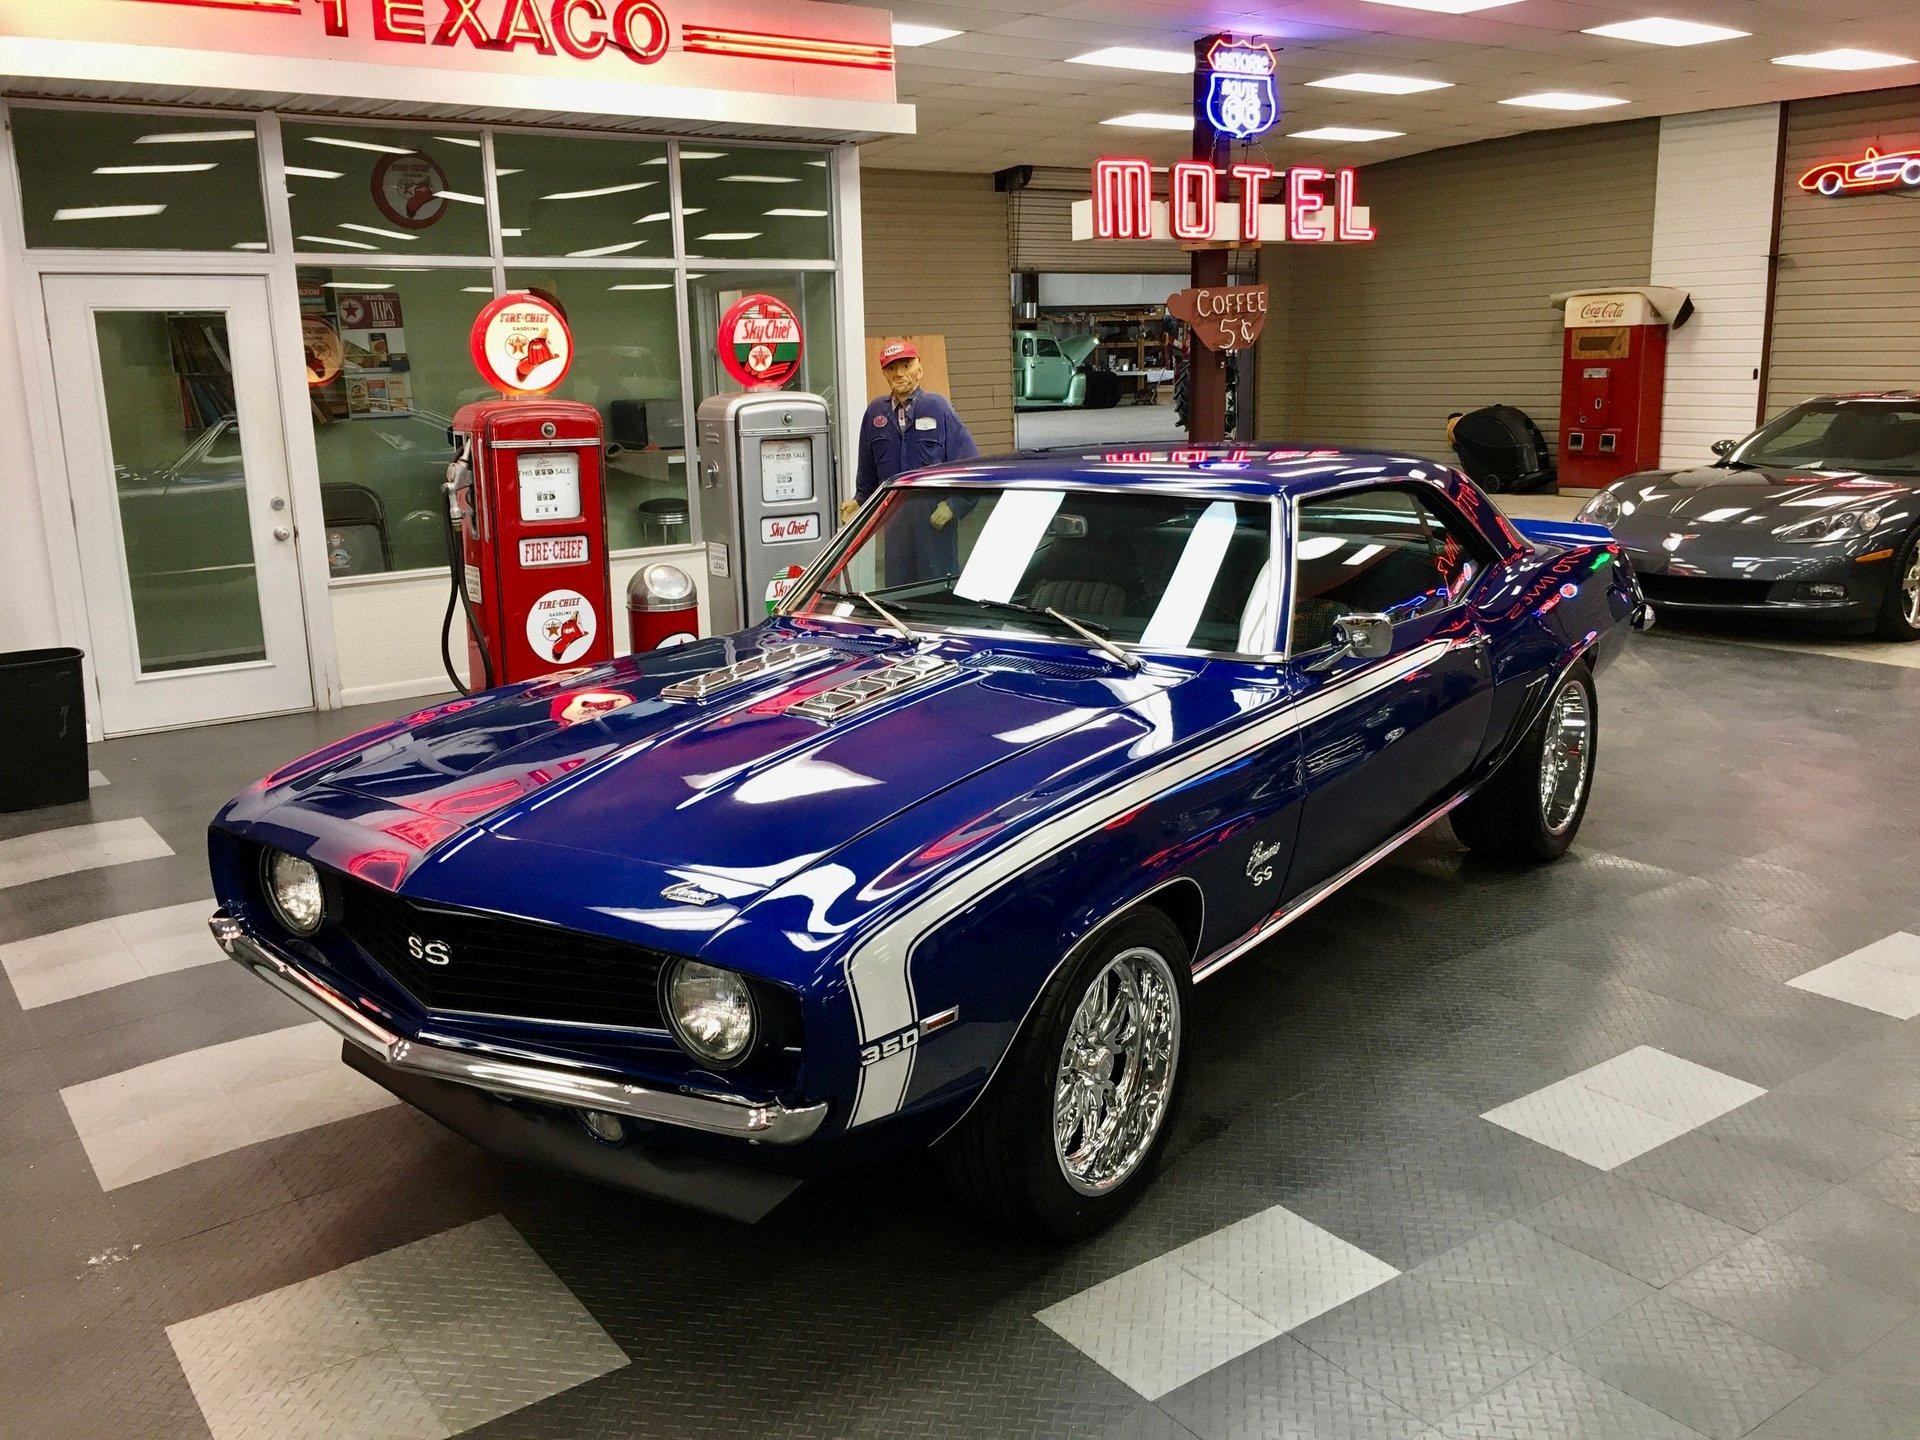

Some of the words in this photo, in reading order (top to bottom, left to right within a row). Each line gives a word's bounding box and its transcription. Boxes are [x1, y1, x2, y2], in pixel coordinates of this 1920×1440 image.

[1221, 79, 1259, 97] ROUTE
[1222, 95, 1261, 129] 66
[1092, 157, 1377, 241] MOTEL
[1196, 289, 1268, 317] COFFEE
[499, 313, 550, 323] FIRE-CHIEF
[742, 320, 765, 342] Sky
[765, 320, 792, 340] Chief
[1218, 317, 1254, 349] 5¢
[769, 522, 785, 538] Sky
[786, 519, 810, 535] Chief
[524, 539, 584, 562] FIRE-CHIEF
[713, 562, 725, 571] LEAD
[538, 597, 581, 610] FIRE-CHIEF
[1252, 865, 1273, 886] SS
[408, 935, 451, 965] SS
[860, 1027, 919, 1067] 350
